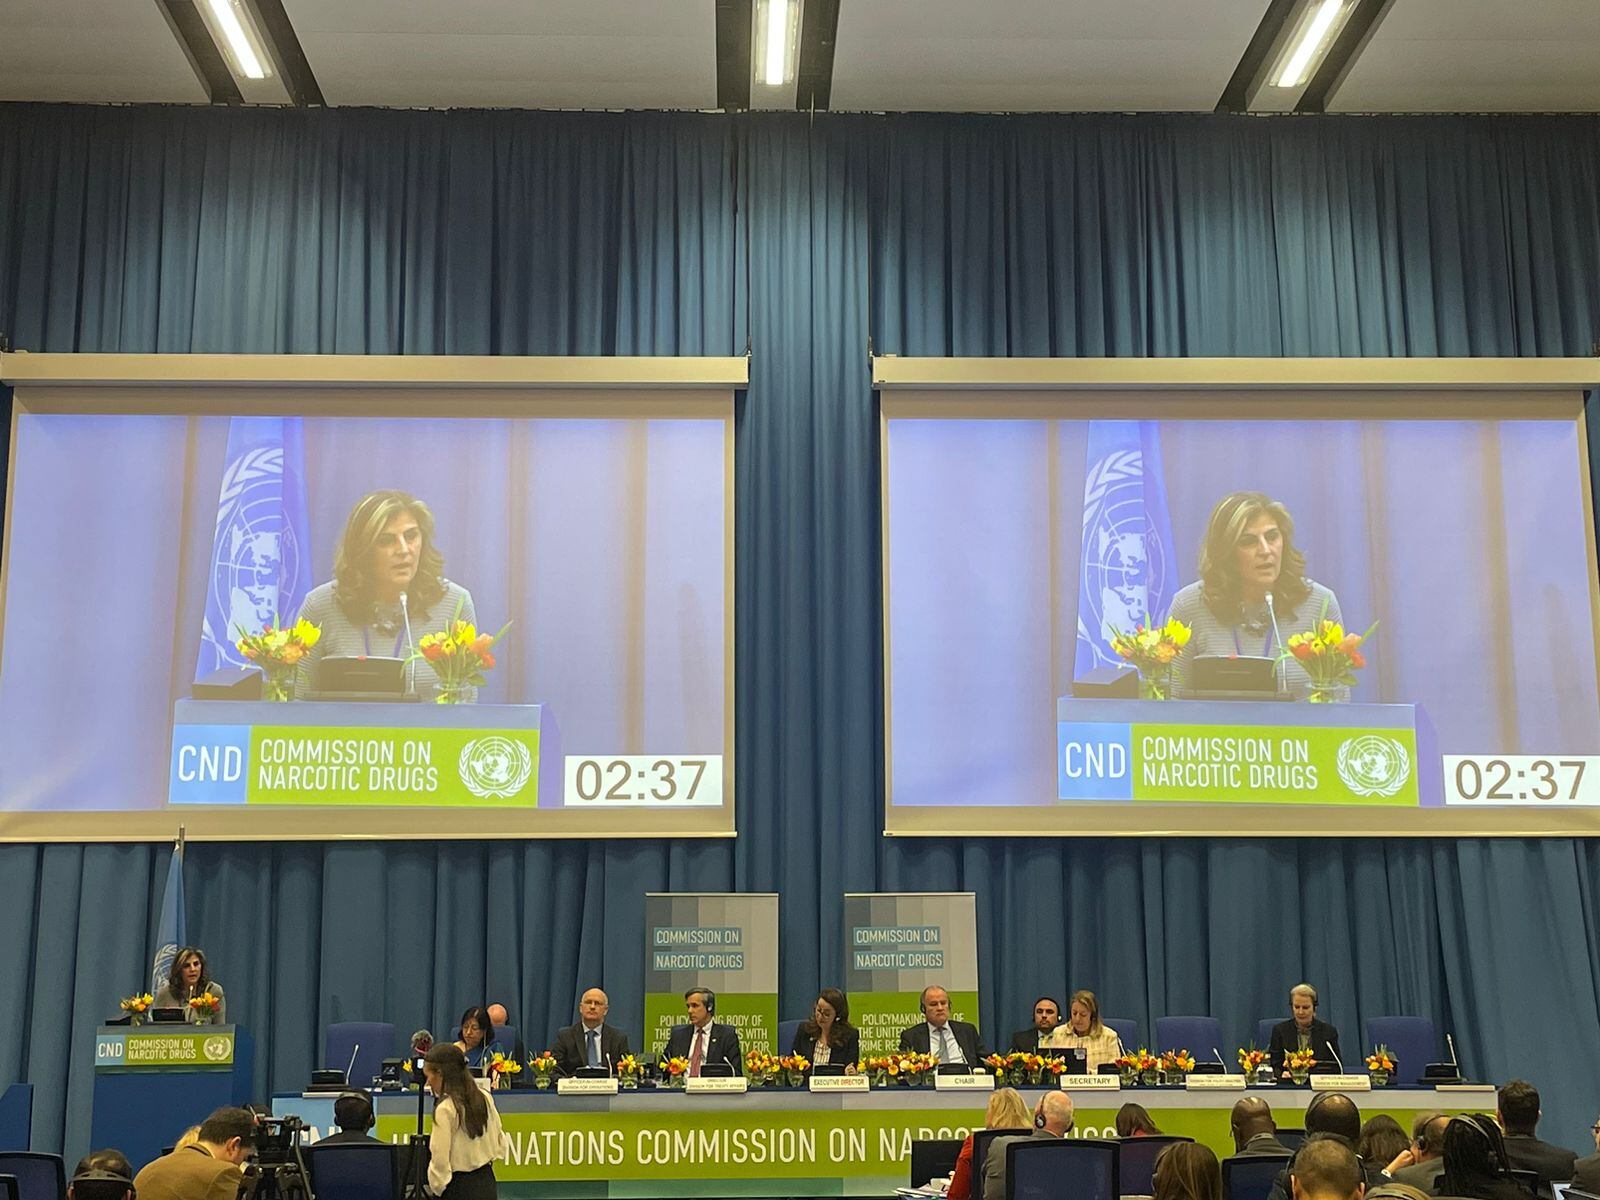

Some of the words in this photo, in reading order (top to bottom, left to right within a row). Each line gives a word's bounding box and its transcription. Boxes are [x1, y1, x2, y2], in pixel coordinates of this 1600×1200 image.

[260, 739, 394, 765] COMMISSION
[403, 741, 431, 765] ON
[1142, 736, 1271, 762] COMMISSION
[1281, 739, 1309, 763] ON
[178, 745, 242, 782] CND
[1065, 742, 1126, 778] CND
[259, 766, 360, 790] NARCOTIC
[368, 767, 438, 792] DRUGS
[576, 760, 707, 801] 02:37
[1143, 763, 1242, 788] NARCOTIC
[1250, 765, 1318, 790] DRUGS
[1455, 759, 1587, 801] 02:37
[656, 930, 721, 944] COMMISSION
[724, 930, 739, 944] ON
[856, 929, 920, 944] COMMISSION
[923, 929, 938, 942] ON
[656, 955, 705, 968] NARCOTIC
[708, 955, 743, 968] DRUGS
[856, 954, 905, 968] NARCOTIC
[908, 953, 942, 967] DRUGS
[660, 1015, 724, 1026] POLICYNG
[726, 1015, 751, 1025] BODY
[751, 1015, 763, 1026] OF
[655, 1028, 671, 1040] THE
[745, 1028, 768, 1040] WITH
[858, 1026, 873, 1039] THE
[98, 1043, 123, 1058] CND
[128, 1039, 180, 1050] COMMISSION
[182, 1039, 194, 1049] ON
[752, 1041, 770, 1053] FOR
[128, 1049, 168, 1060] NARCOTIC
[169, 1049, 197, 1059] DRUGS
[813, 1078, 840, 1086] EXECUTIVE
[840, 1078, 865, 1086] DIRECTOR
[954, 1077, 976, 1085] CHAIR
[1069, 1077, 1111, 1085] SECRETARY
[504, 1130, 624, 1166] NATIONS
[637, 1127, 816, 1164] COMMISSION
[829, 1127, 866, 1162] ON
